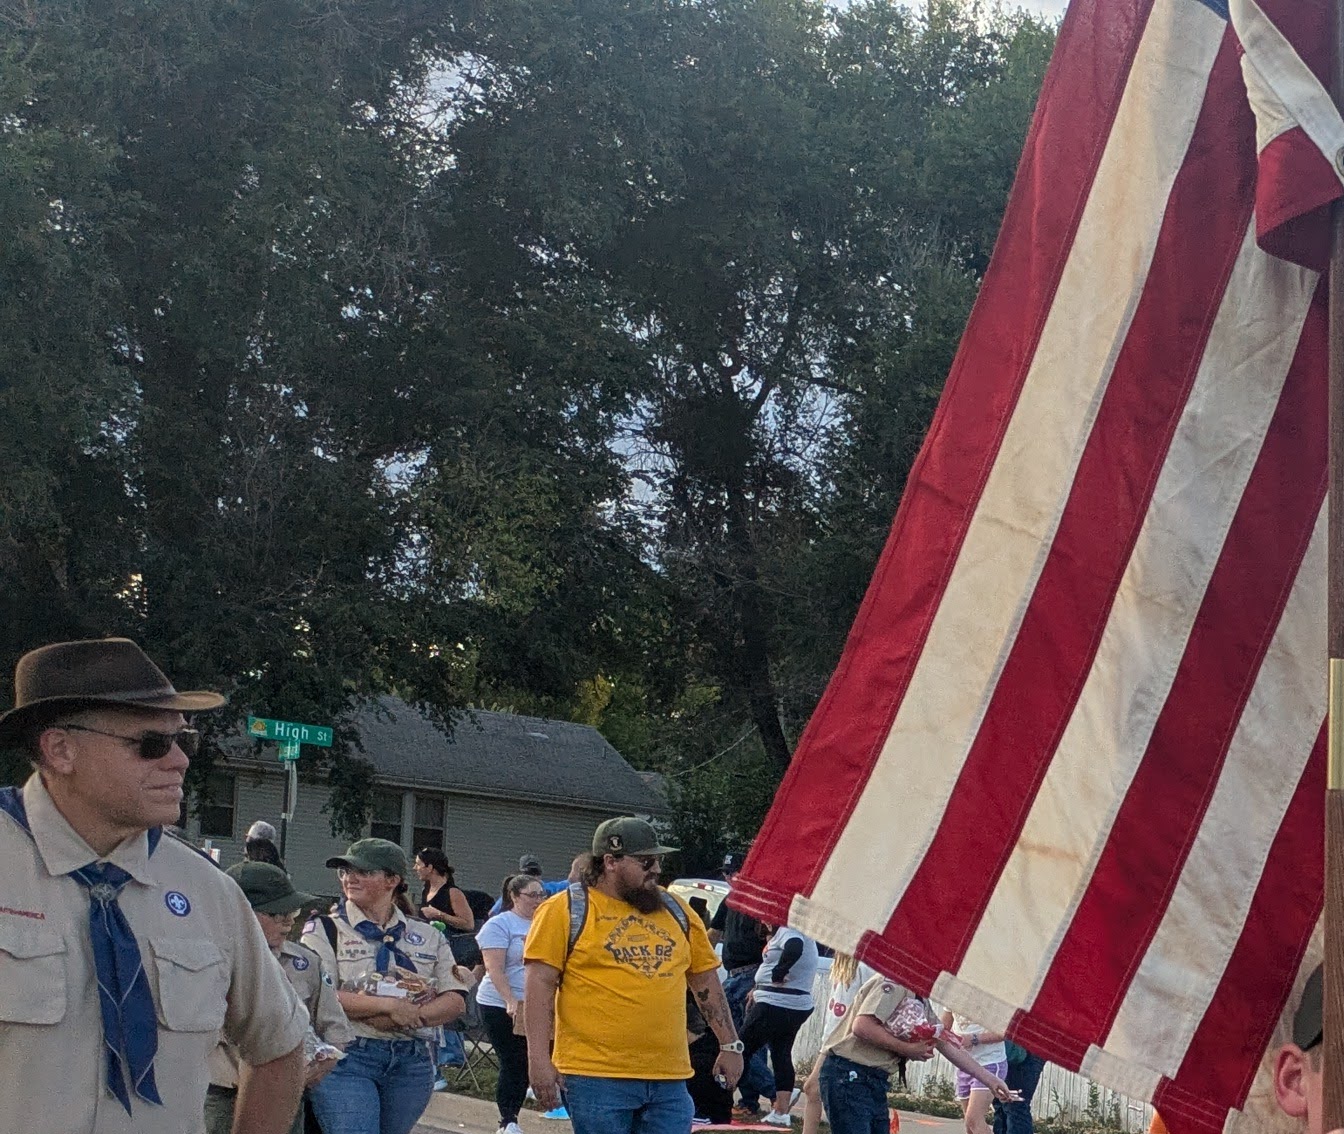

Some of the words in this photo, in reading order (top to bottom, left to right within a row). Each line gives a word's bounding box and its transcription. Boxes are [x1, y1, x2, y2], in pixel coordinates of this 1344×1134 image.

[274, 721, 309, 740] High
[317, 730, 327, 741] St
[613, 944, 651, 959] PACK
[655, 944, 673, 957] 62
